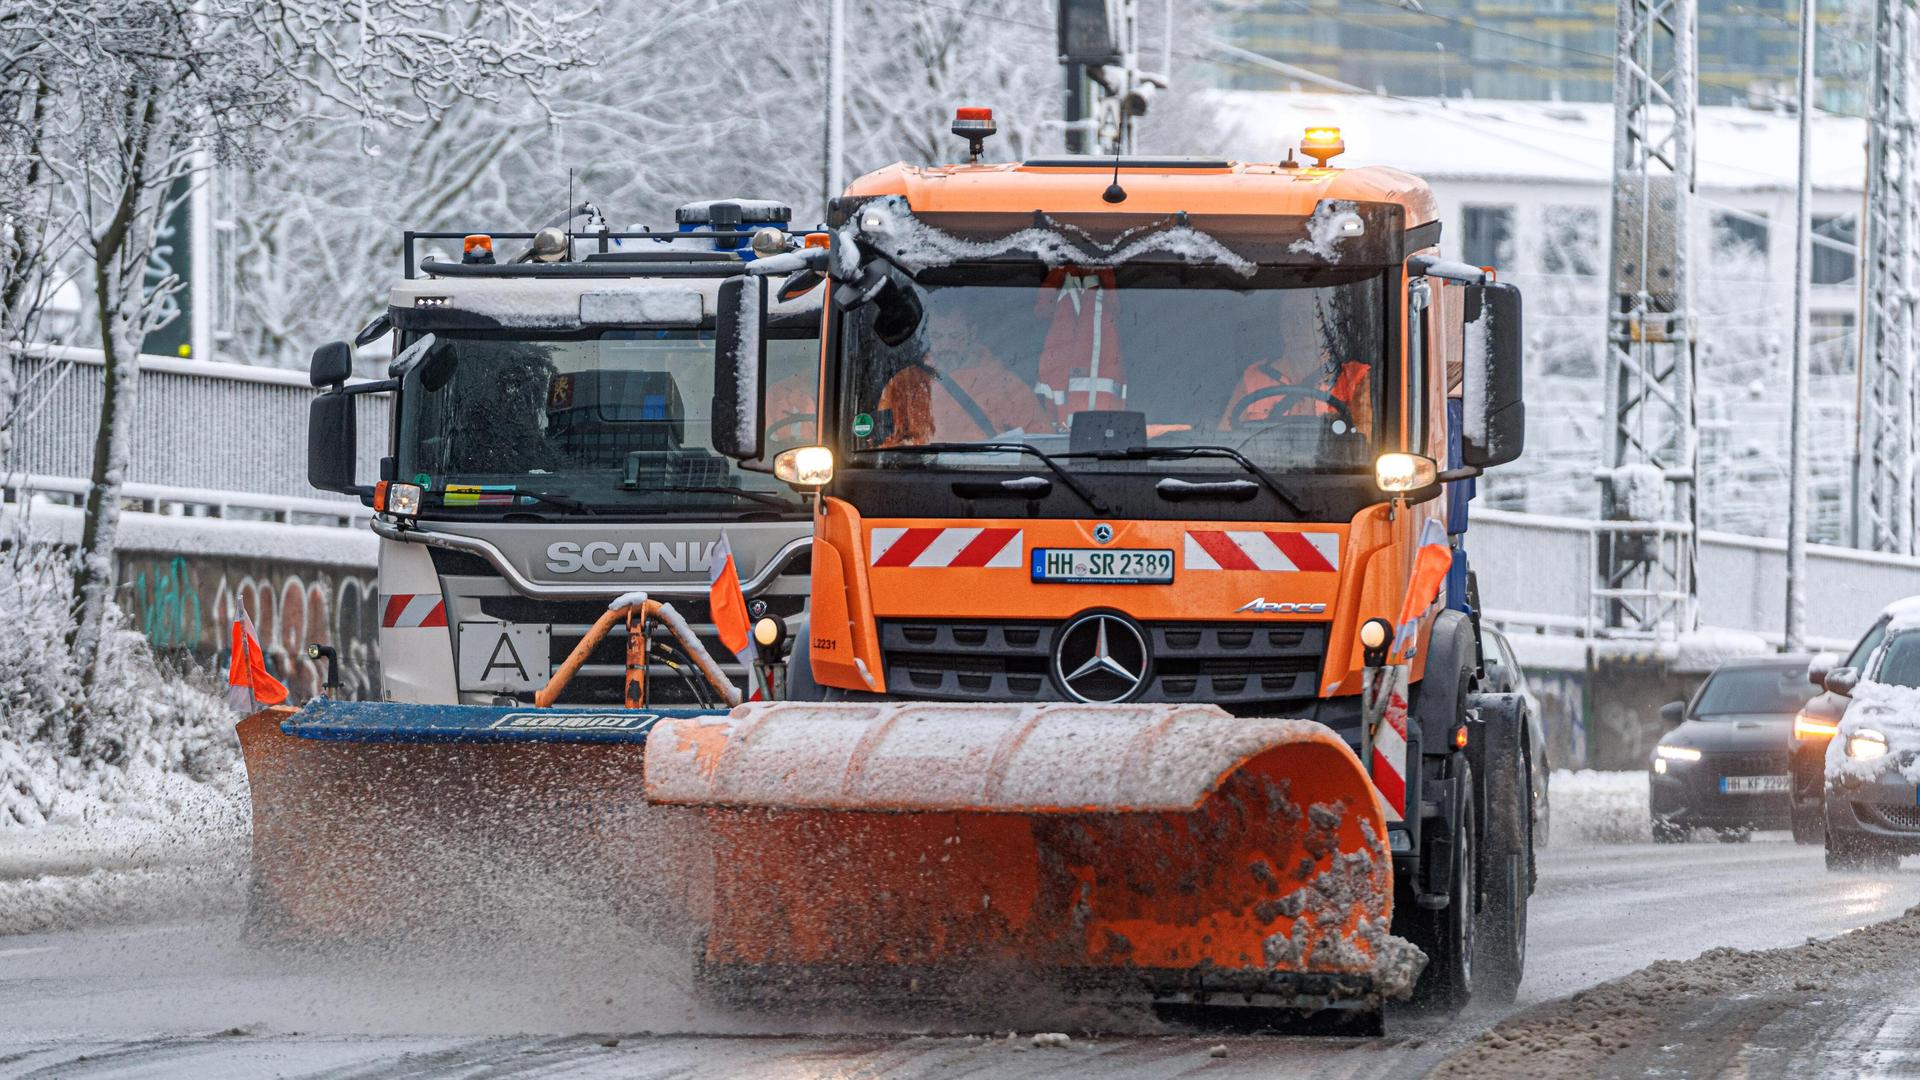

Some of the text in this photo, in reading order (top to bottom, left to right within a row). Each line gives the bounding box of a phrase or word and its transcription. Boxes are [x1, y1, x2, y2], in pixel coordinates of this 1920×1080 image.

[1047, 553, 1170, 575] HH SR 2389
[480, 632, 530, 681] A
[1727, 777, 1741, 790] HH
